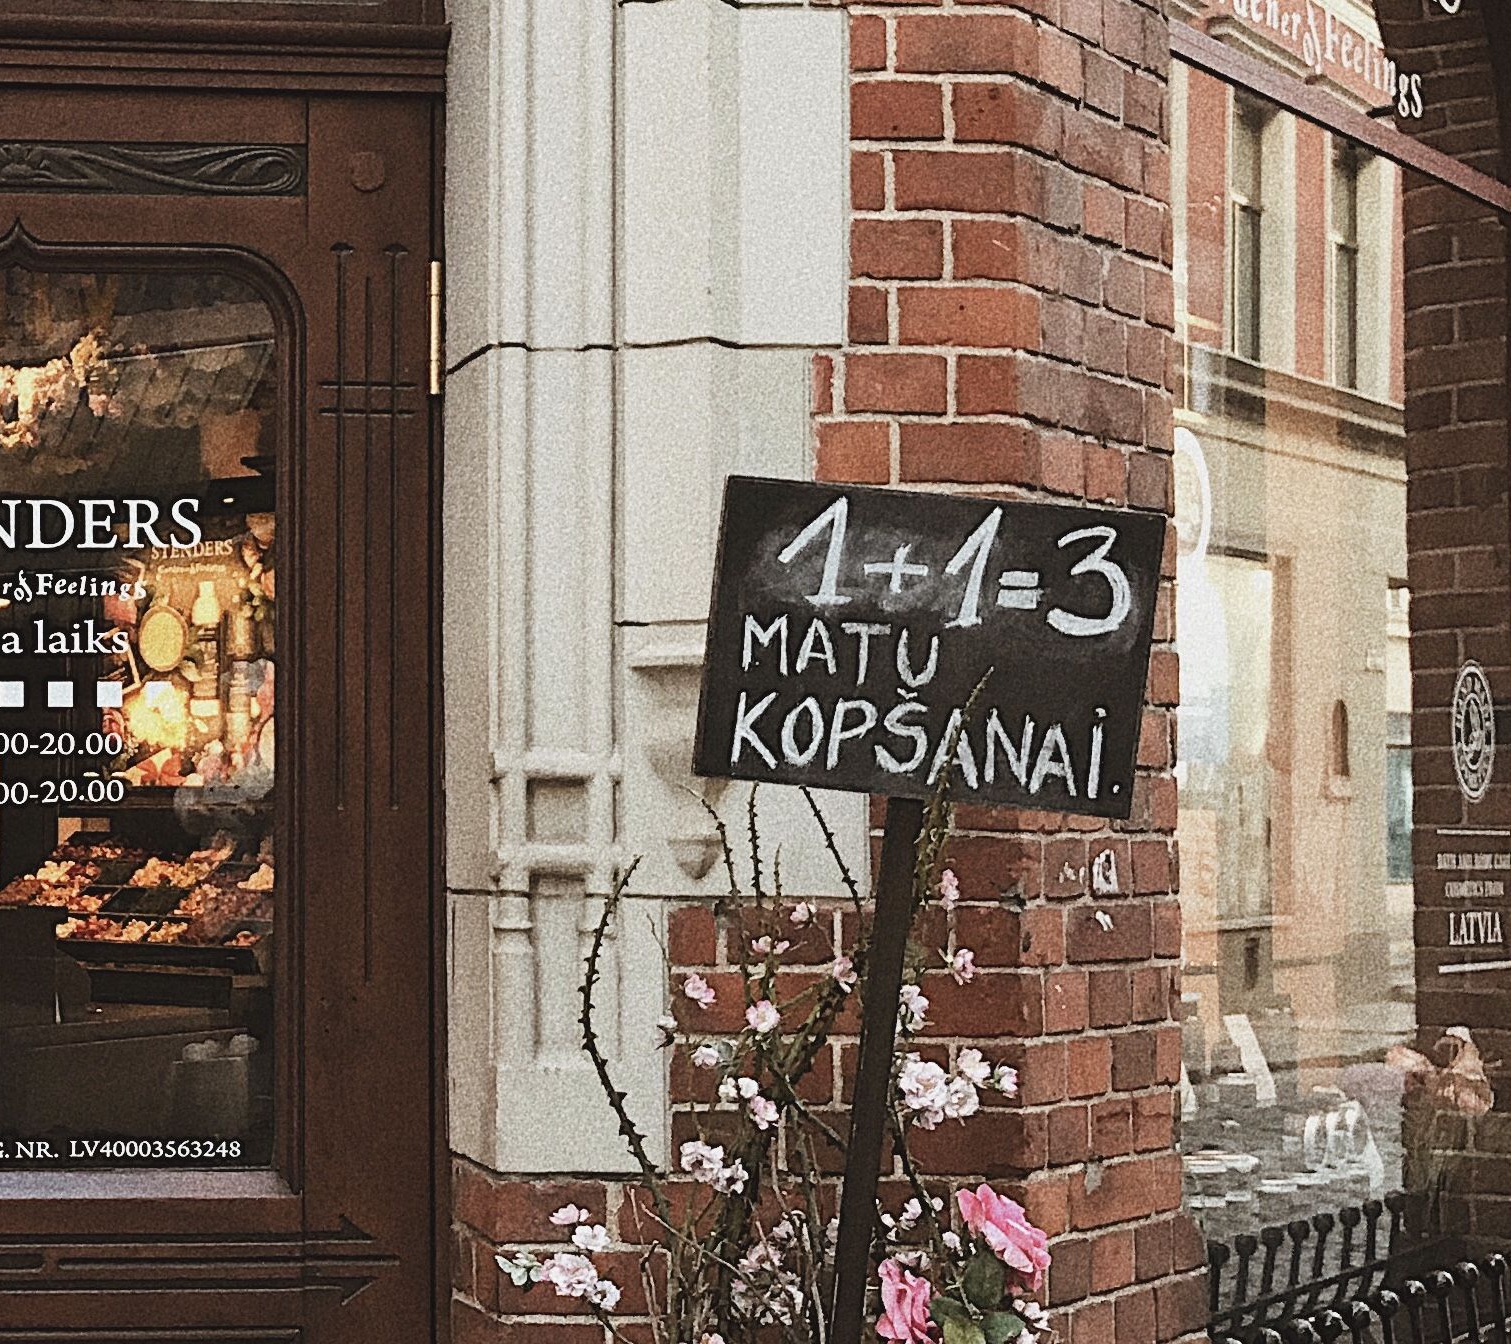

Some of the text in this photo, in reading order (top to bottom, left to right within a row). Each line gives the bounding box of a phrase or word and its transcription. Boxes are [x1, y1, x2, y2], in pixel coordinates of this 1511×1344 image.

[1324, 6, 1423, 119] Feelings
[36, 573, 147, 601] Feelings
[33, 619, 129, 654] laiks
[741, 613, 939, 688] MATU
[1449, 911, 1503, 946] LATVIA
[15, 1141, 60, 1159] NR.
[69, 1140, 242, 1159] LV40003563248
